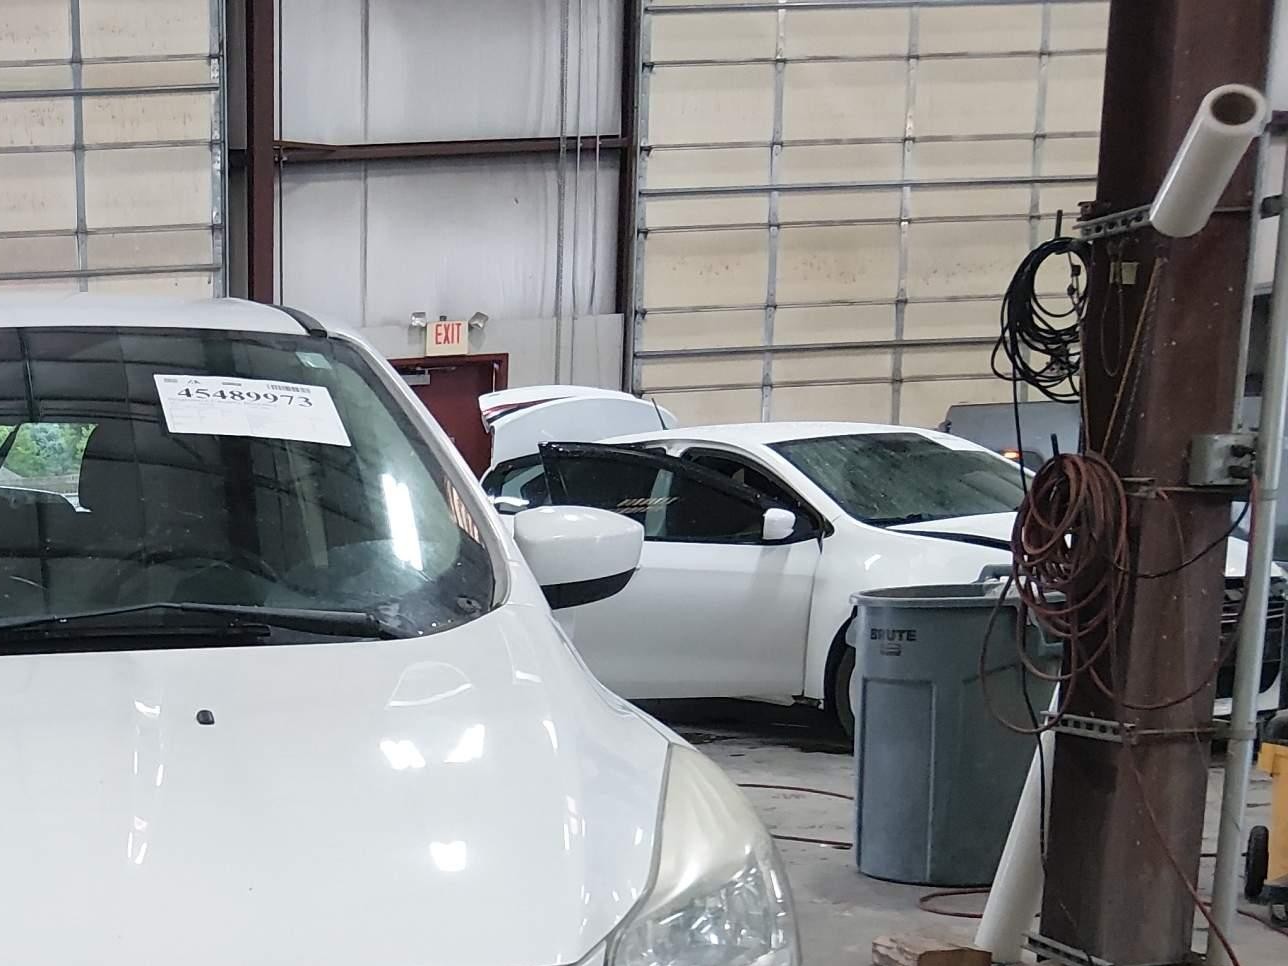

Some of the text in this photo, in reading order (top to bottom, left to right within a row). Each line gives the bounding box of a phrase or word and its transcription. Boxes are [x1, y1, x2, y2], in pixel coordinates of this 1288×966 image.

[435, 323, 462, 345] EXIT
[177, 387, 313, 408] 45489973
[870, 628, 917, 641] BRUTE
